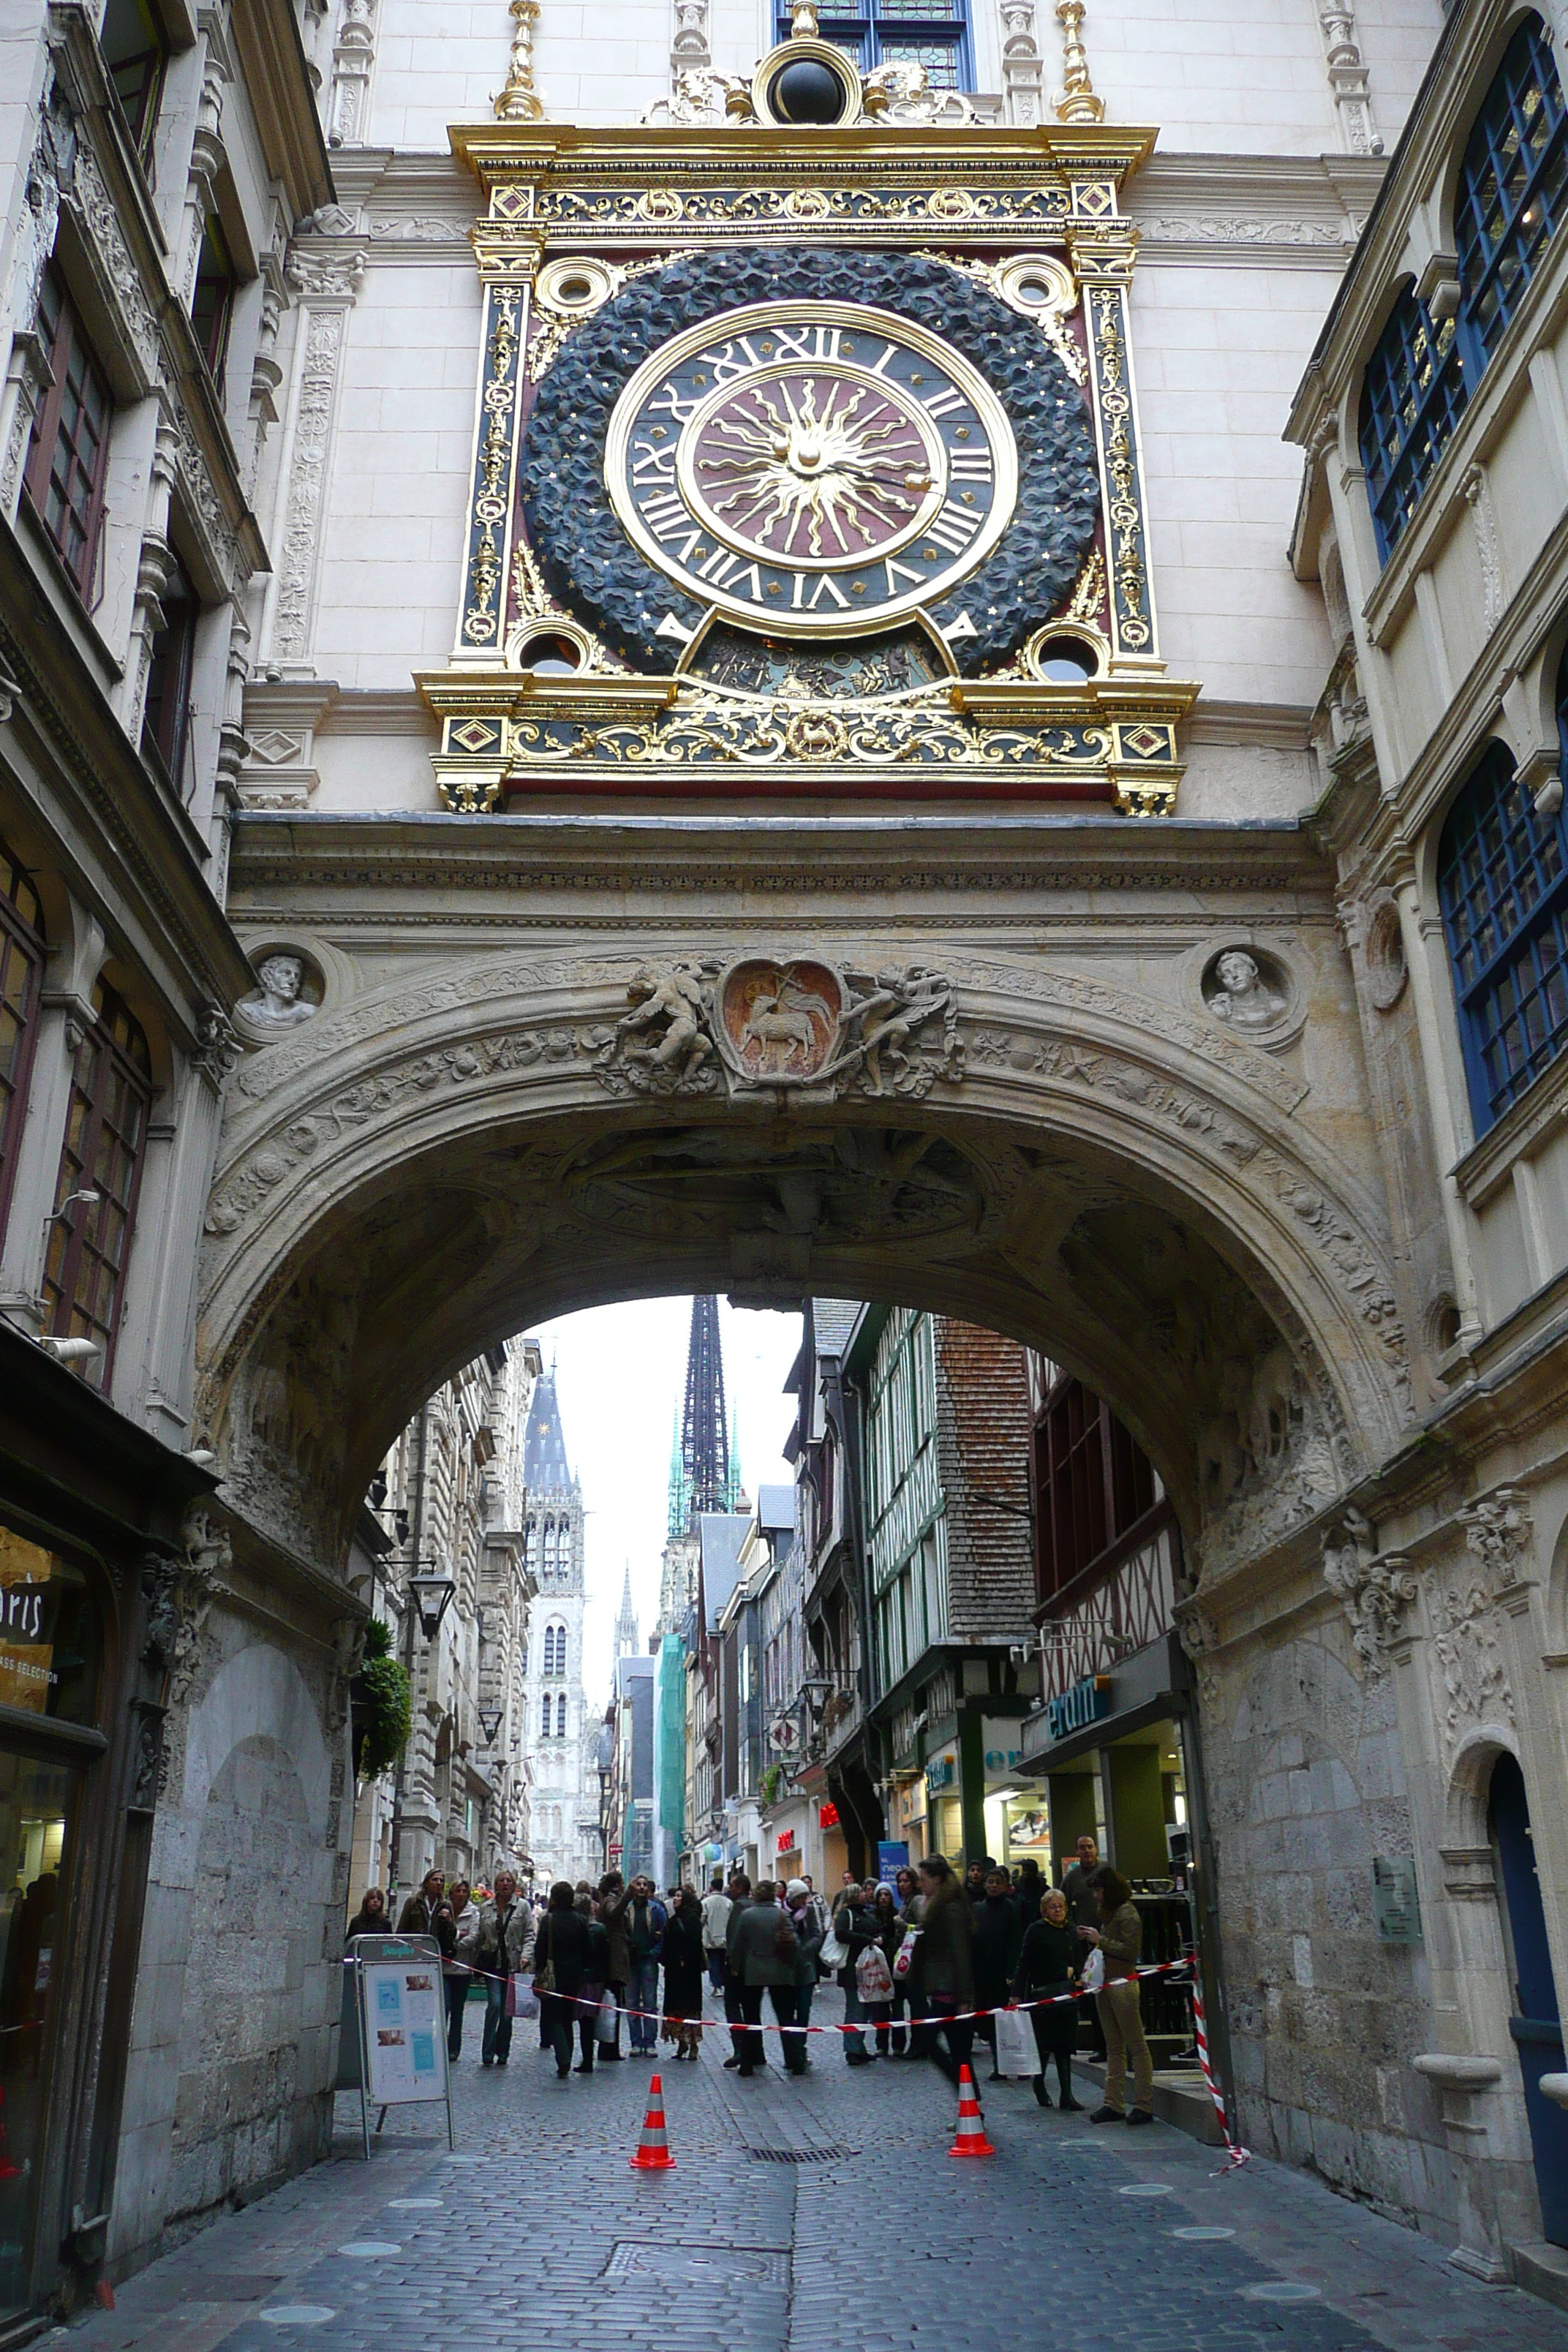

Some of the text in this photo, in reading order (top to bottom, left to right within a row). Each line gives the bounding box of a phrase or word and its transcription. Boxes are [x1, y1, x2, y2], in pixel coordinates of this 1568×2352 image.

[697, 336, 763, 385] XI
[770, 327, 843, 360] XII
[871, 344, 900, 374] I
[648, 382, 703, 424] X
[920, 385, 968, 420] II
[633, 440, 677, 487] IX
[949, 446, 992, 483] III
[638, 489, 703, 565] VIII
[922, 499, 984, 555] IIII
[695, 545, 764, 602] VII
[790, 573, 851, 609] VI
[885, 557, 927, 596] V
[0, 1572, 42, 1637] ris
[17, 1661, 59, 1684] SELECTION
